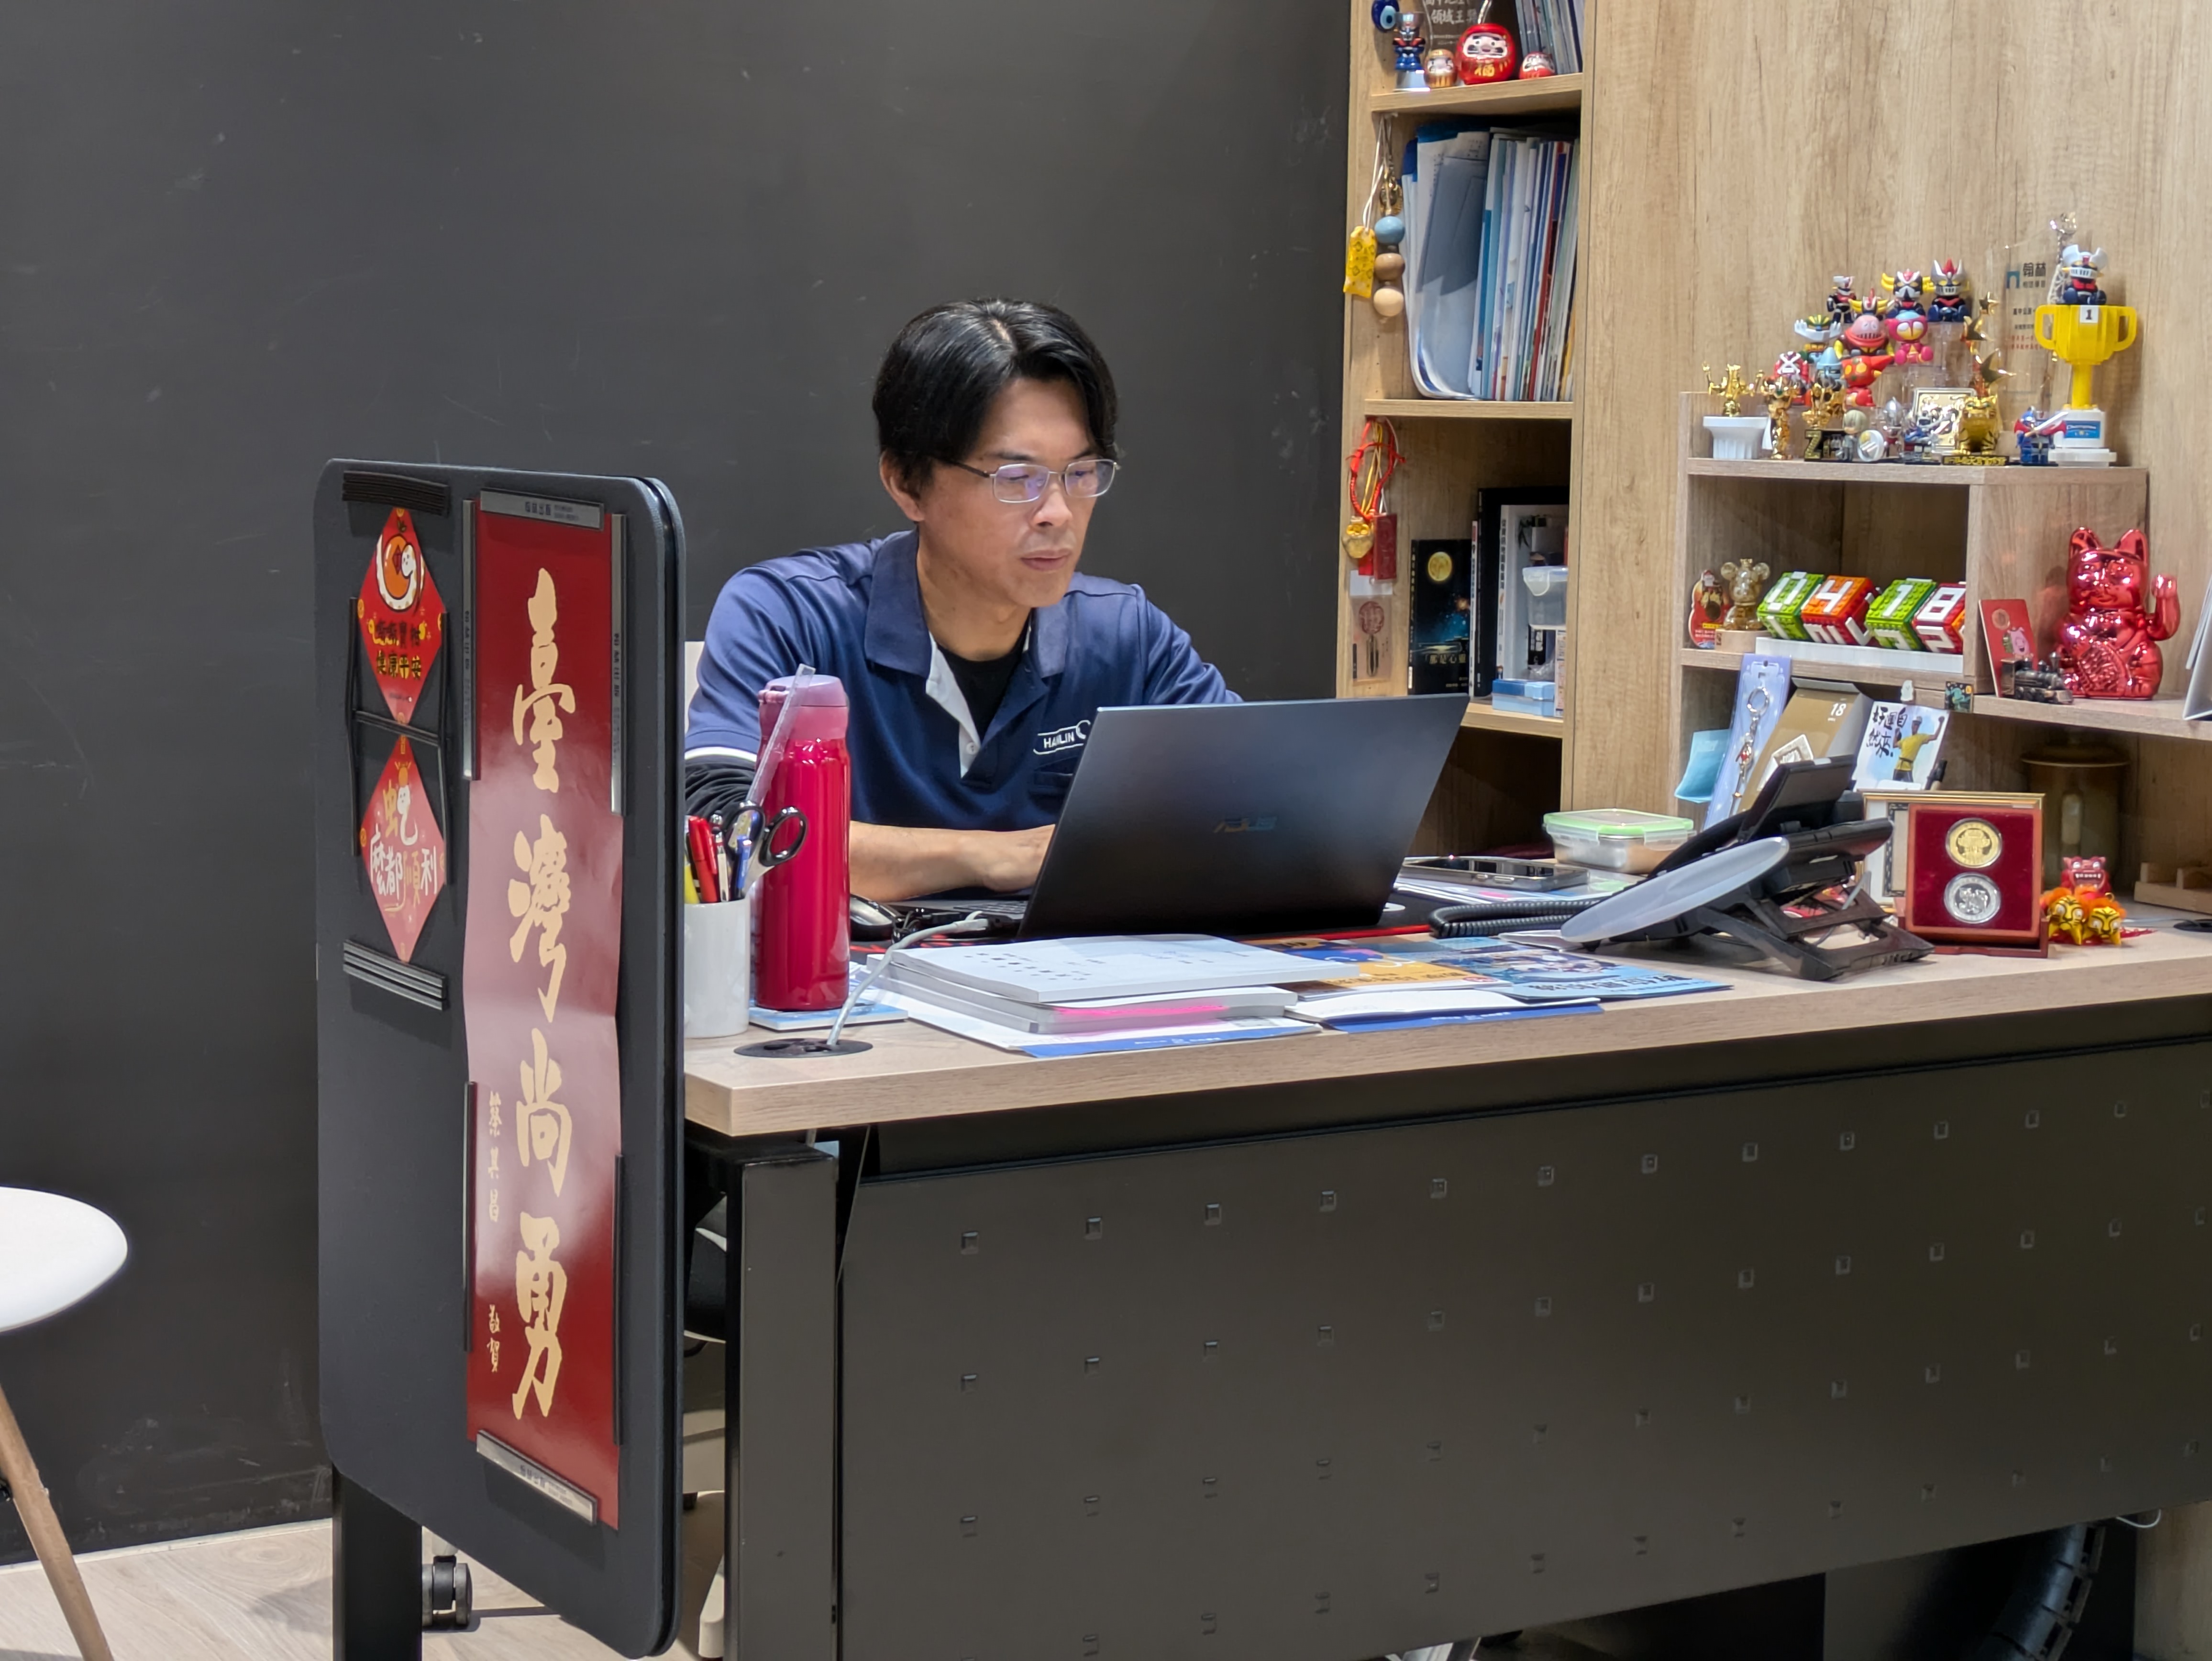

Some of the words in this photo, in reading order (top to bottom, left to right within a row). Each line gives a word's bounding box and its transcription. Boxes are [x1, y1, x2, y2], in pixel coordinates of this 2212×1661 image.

[1474, 64, 1495, 77] 福
[2085, 309, 2092, 320] 1
[376, 650, 422, 680] 健康平安
[1831, 703, 1847, 717] 18
